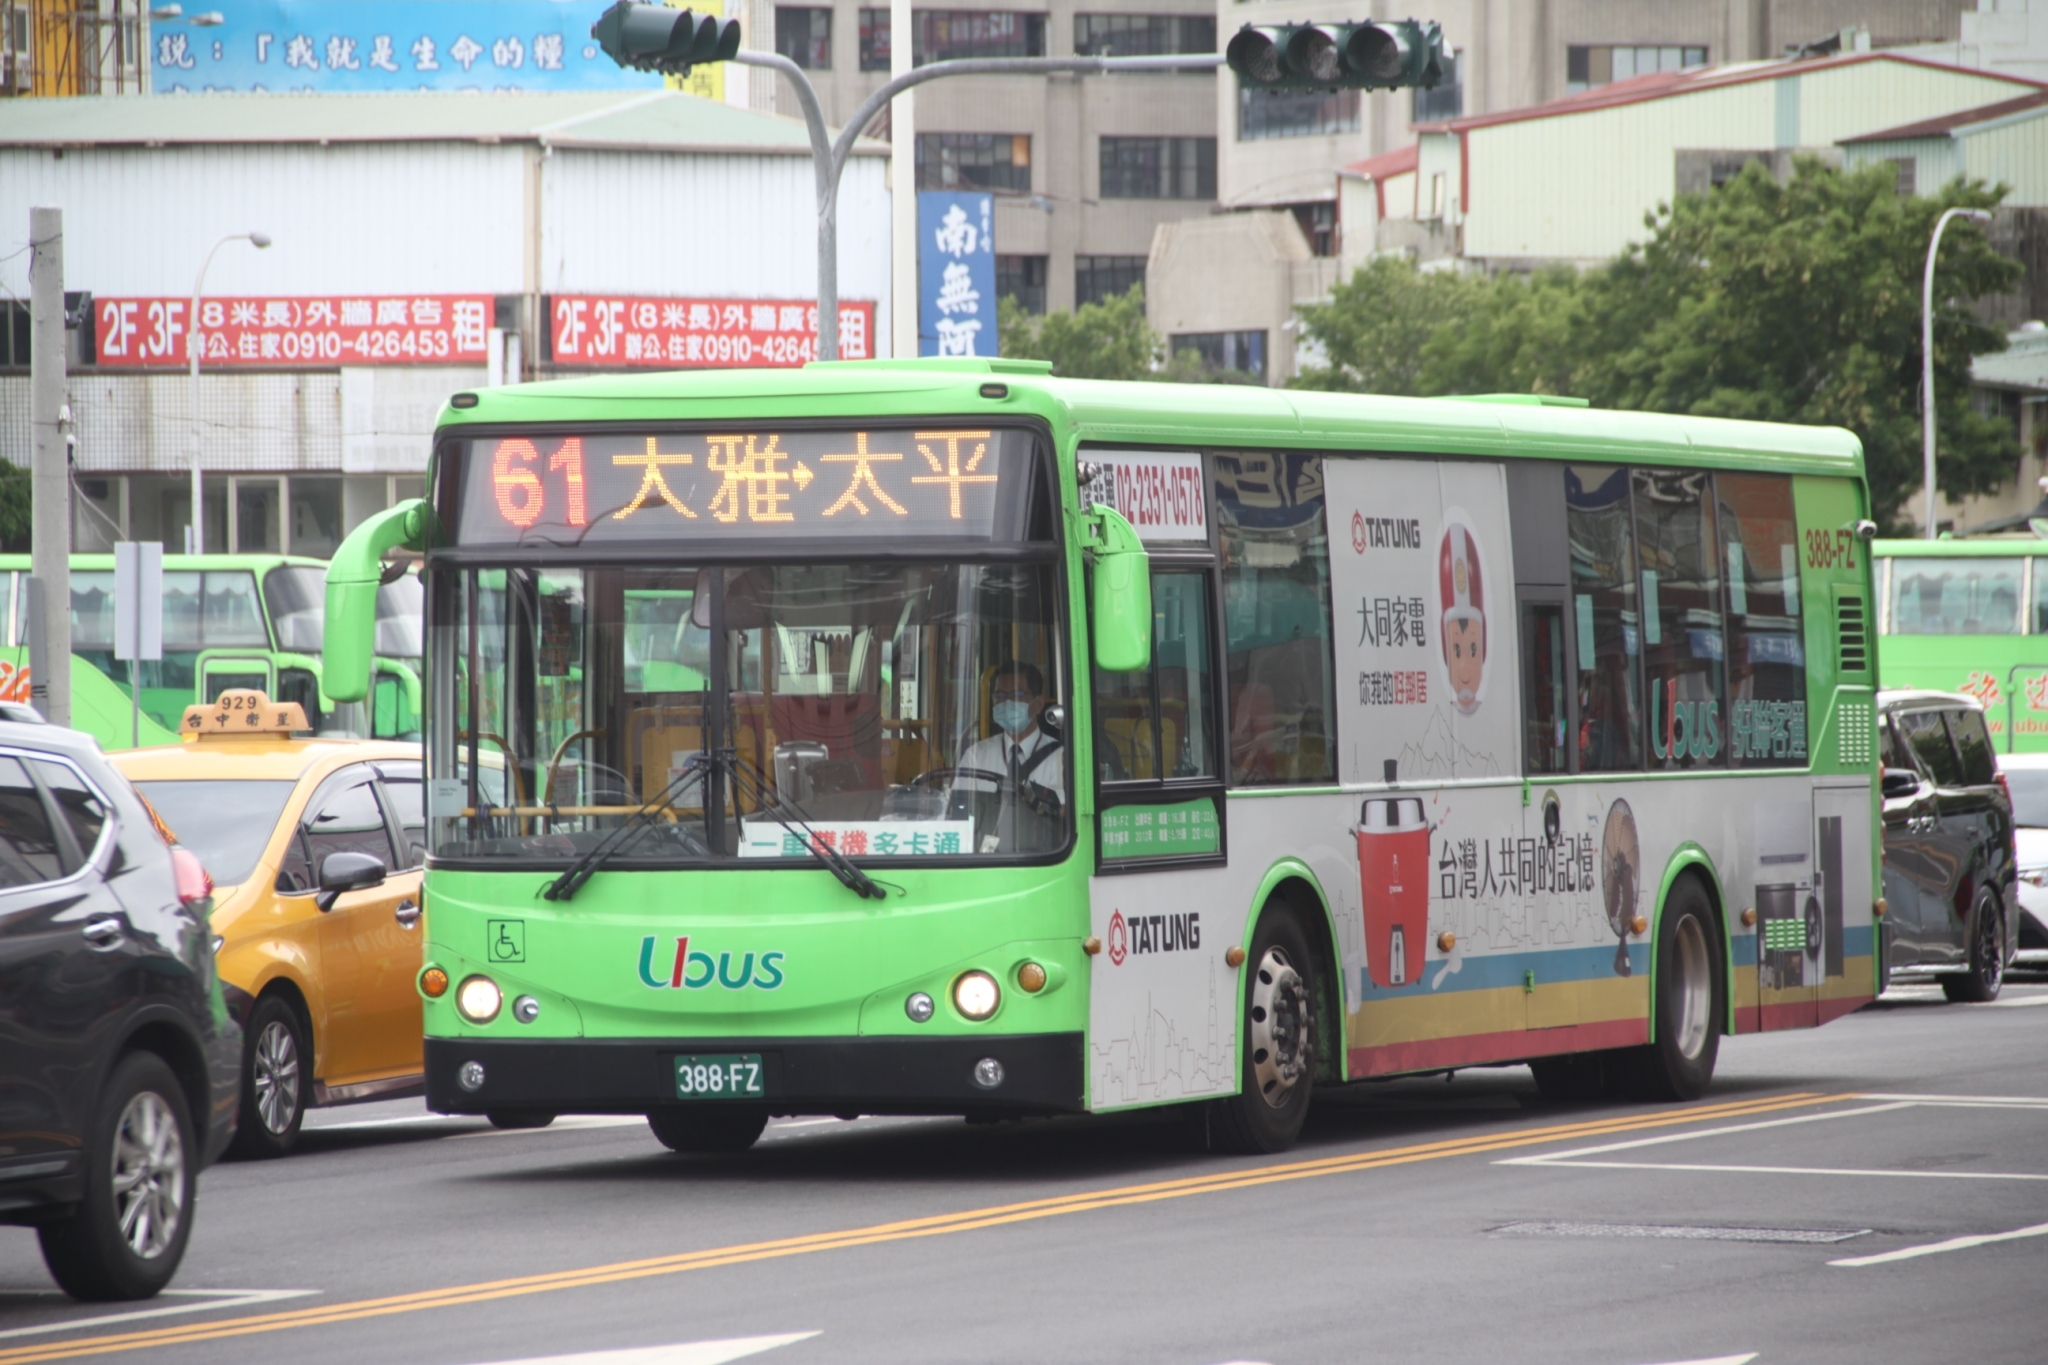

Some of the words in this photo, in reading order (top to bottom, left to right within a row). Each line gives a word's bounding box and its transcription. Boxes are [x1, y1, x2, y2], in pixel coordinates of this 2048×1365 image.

[102, 301, 184, 358] 2F.3F
[198, 298, 444, 328] 8米長)外牆廣告
[452, 300, 487, 353] 租
[557, 299, 625, 358] 2F.3F
[839, 309, 867, 360] 租
[493, 436, 586, 526] 61
[612, 434, 795, 522] 大雅
[820, 431, 998, 519] 太平
[1116, 464, 1203, 526] 02-2351-0578
[1365, 517, 1421, 549] TATUNG
[1805, 529, 1856, 569] 388-FZ
[1356, 596, 1427, 647] 大同家電
[187, 712, 290, 728] 台中衛星
[222, 696, 257, 710] 929
[1652, 678, 1719, 760] Ubus
[751, 830, 961, 856] 一車雙機多卡通
[1439, 832, 1595, 899] 台灣人共同的記憶
[1128, 912, 1200, 955] TATUNG
[638, 935, 785, 990] Ubus
[678, 1063, 761, 1093] 388-FZ
